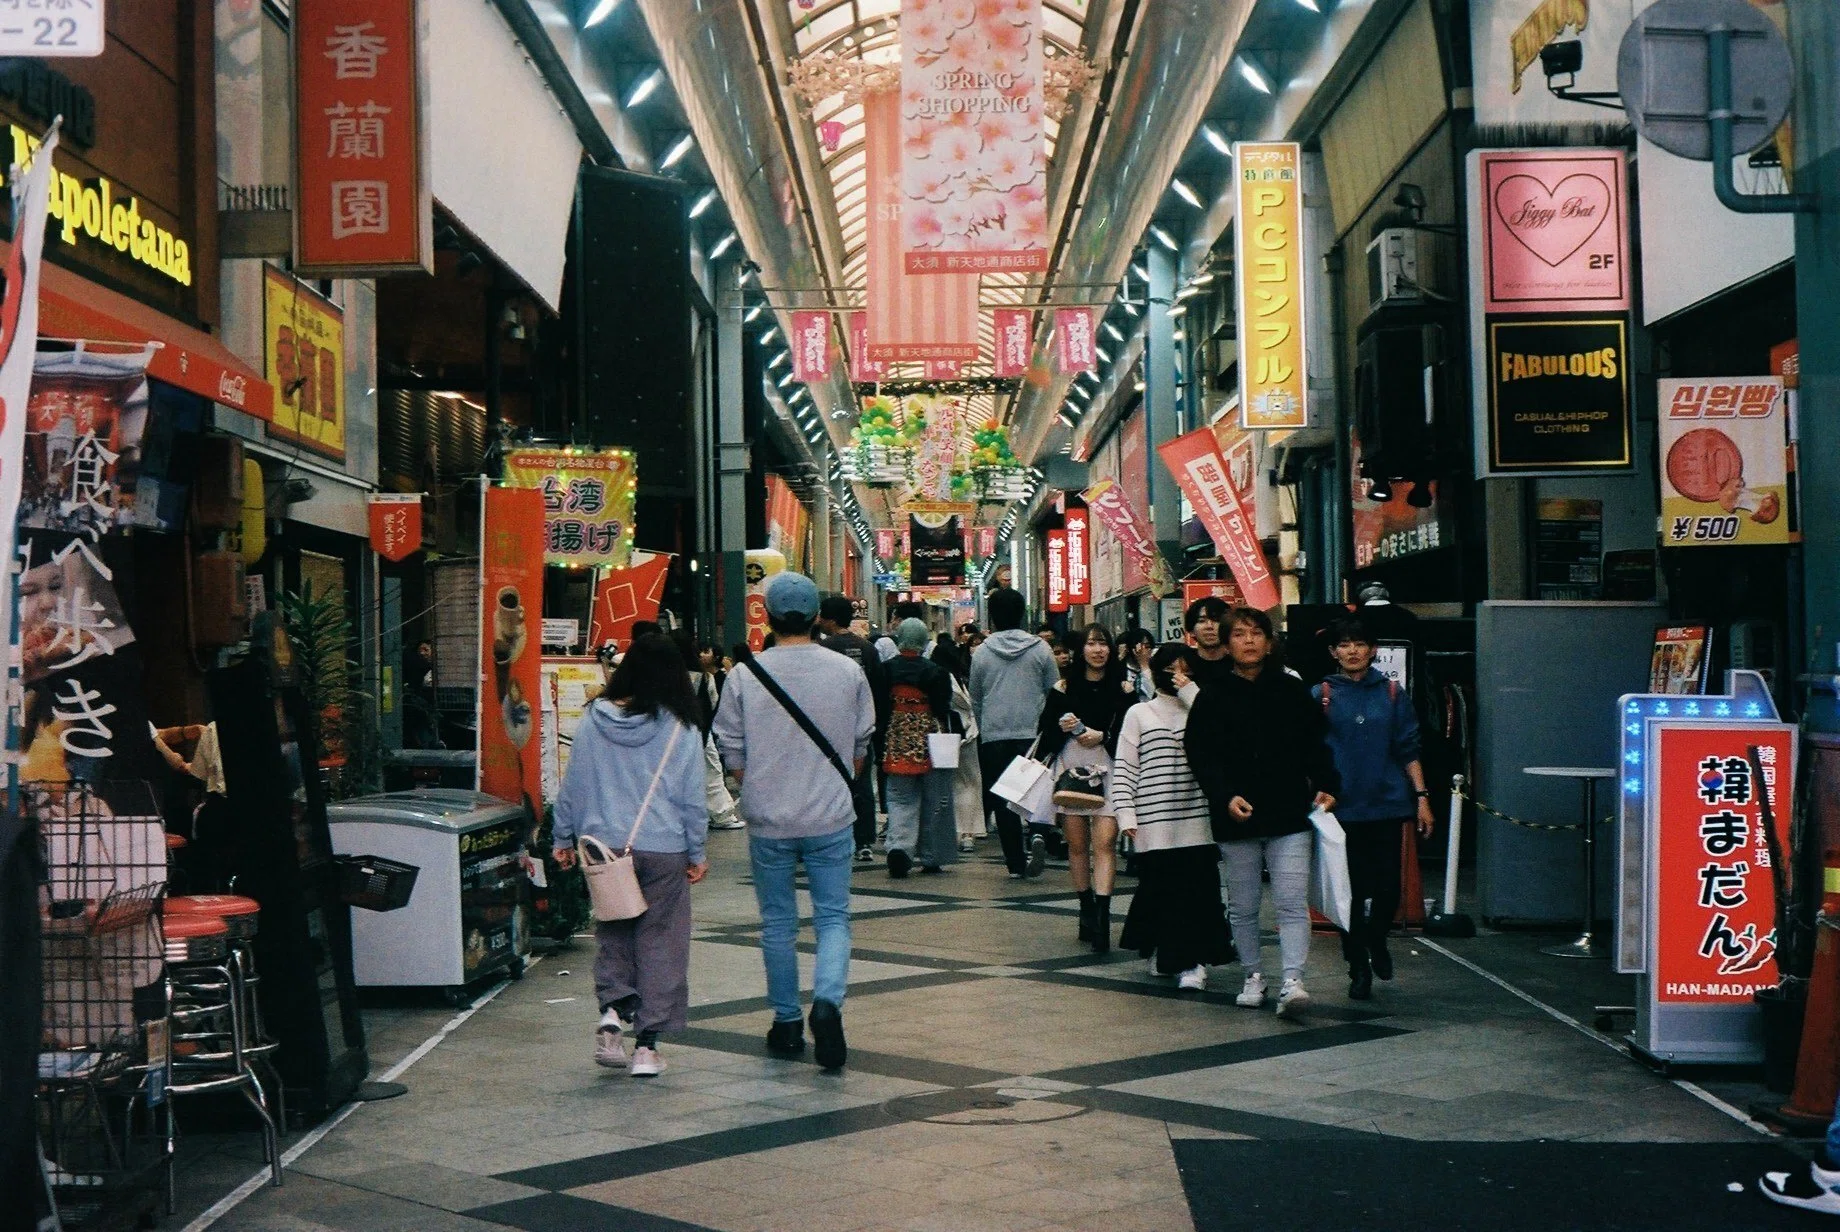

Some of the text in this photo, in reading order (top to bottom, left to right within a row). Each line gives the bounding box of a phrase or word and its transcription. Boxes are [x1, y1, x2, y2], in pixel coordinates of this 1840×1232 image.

[934, 72, 1014, 90] SPRING
[919, 96, 1031, 114] SHOPPING
[323, 21, 391, 240] 香蘭園
[1510, 198, 1557, 229] Jiggy
[912, 255, 1040, 269] 大須 新天地通商店街
[1589, 254, 1614, 270] 2F
[1254, 188, 1293, 384] PCコンフル
[1501, 347, 1617, 382] FABULOUS
[1668, 384, 1781, 419] 십원빵
[1533, 423, 1590, 434] CLOTHING
[544, 477, 604, 514] 台湾
[396, 507, 407, 544] ペイペイ
[544, 521, 620, 553] 揚げ
[48, 428, 120, 758] 食べ歩き
[1168, 616, 1181, 627] WE
[1697, 756, 1755, 958] 韓まだん
[1665, 982, 1778, 996] HAN-MADA
